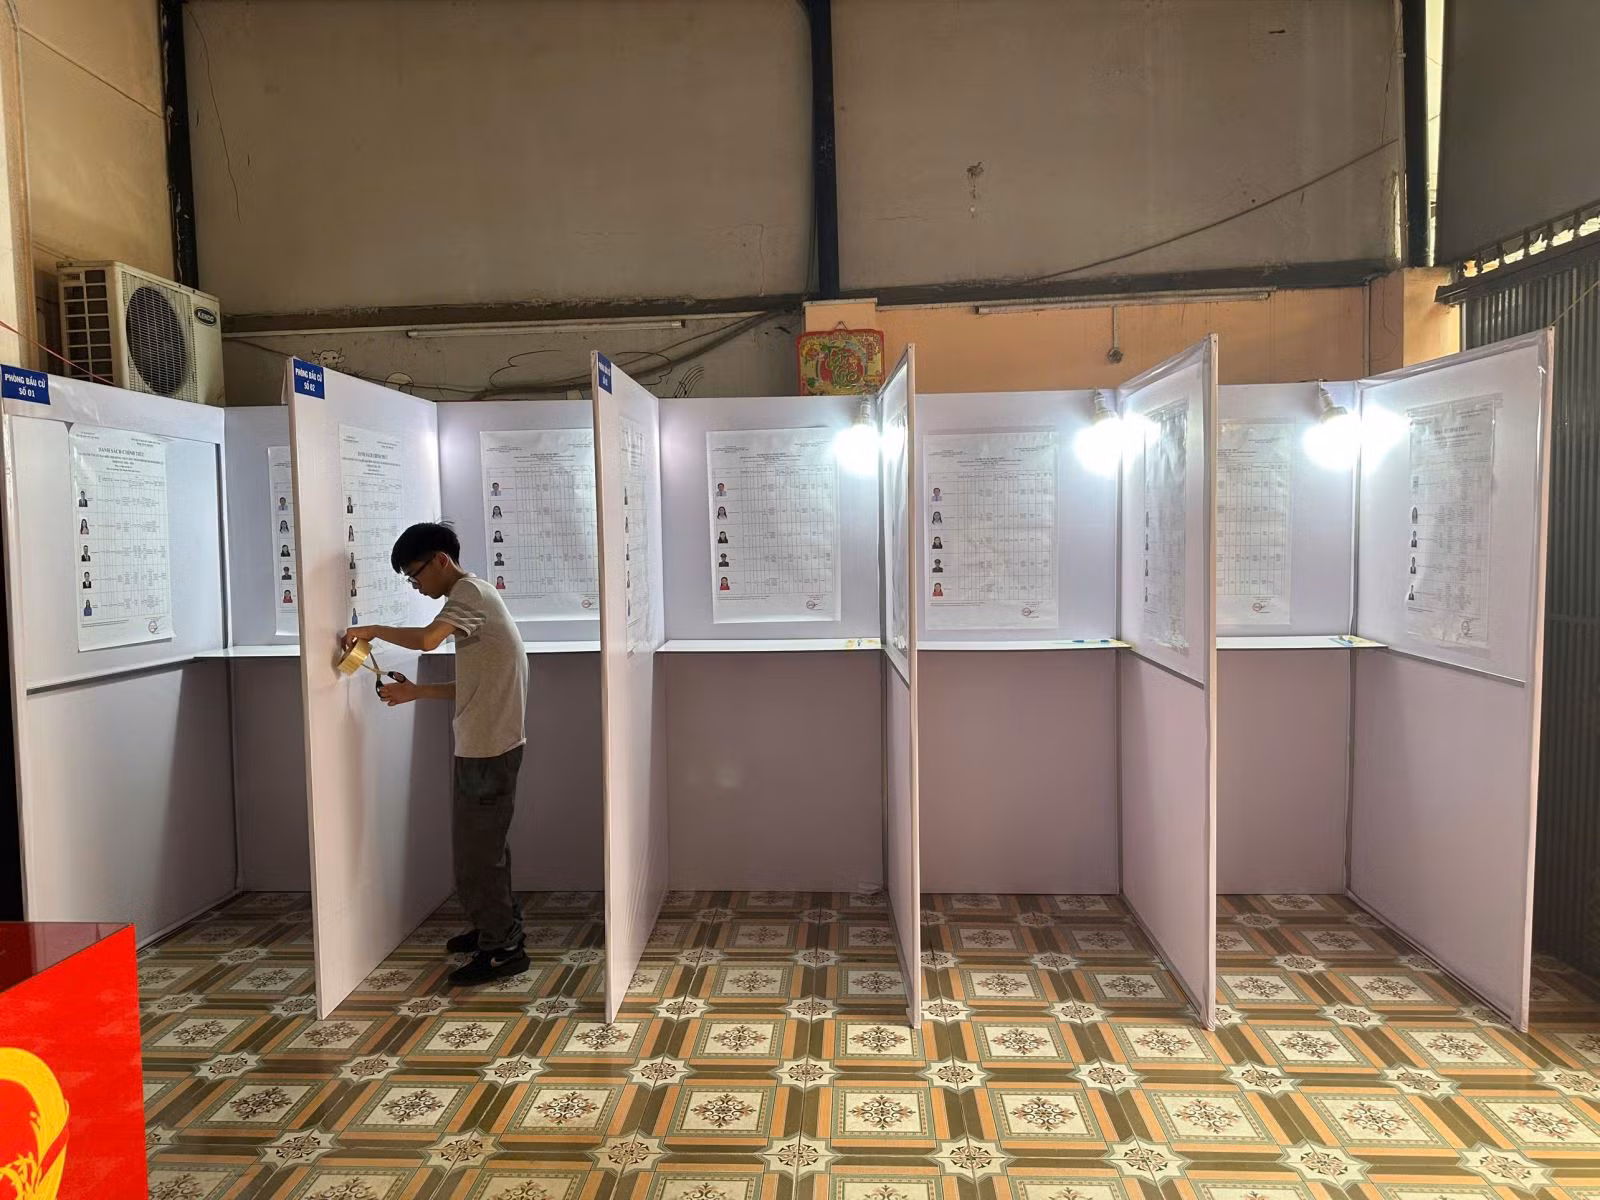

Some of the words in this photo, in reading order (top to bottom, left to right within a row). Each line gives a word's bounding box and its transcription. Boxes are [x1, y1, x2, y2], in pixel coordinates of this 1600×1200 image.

[4, 372, 25, 384] PHÒNG
[18, 386, 27, 396] SỐ
[27, 389, 35, 398] 01
[310, 384, 316, 392] 02
